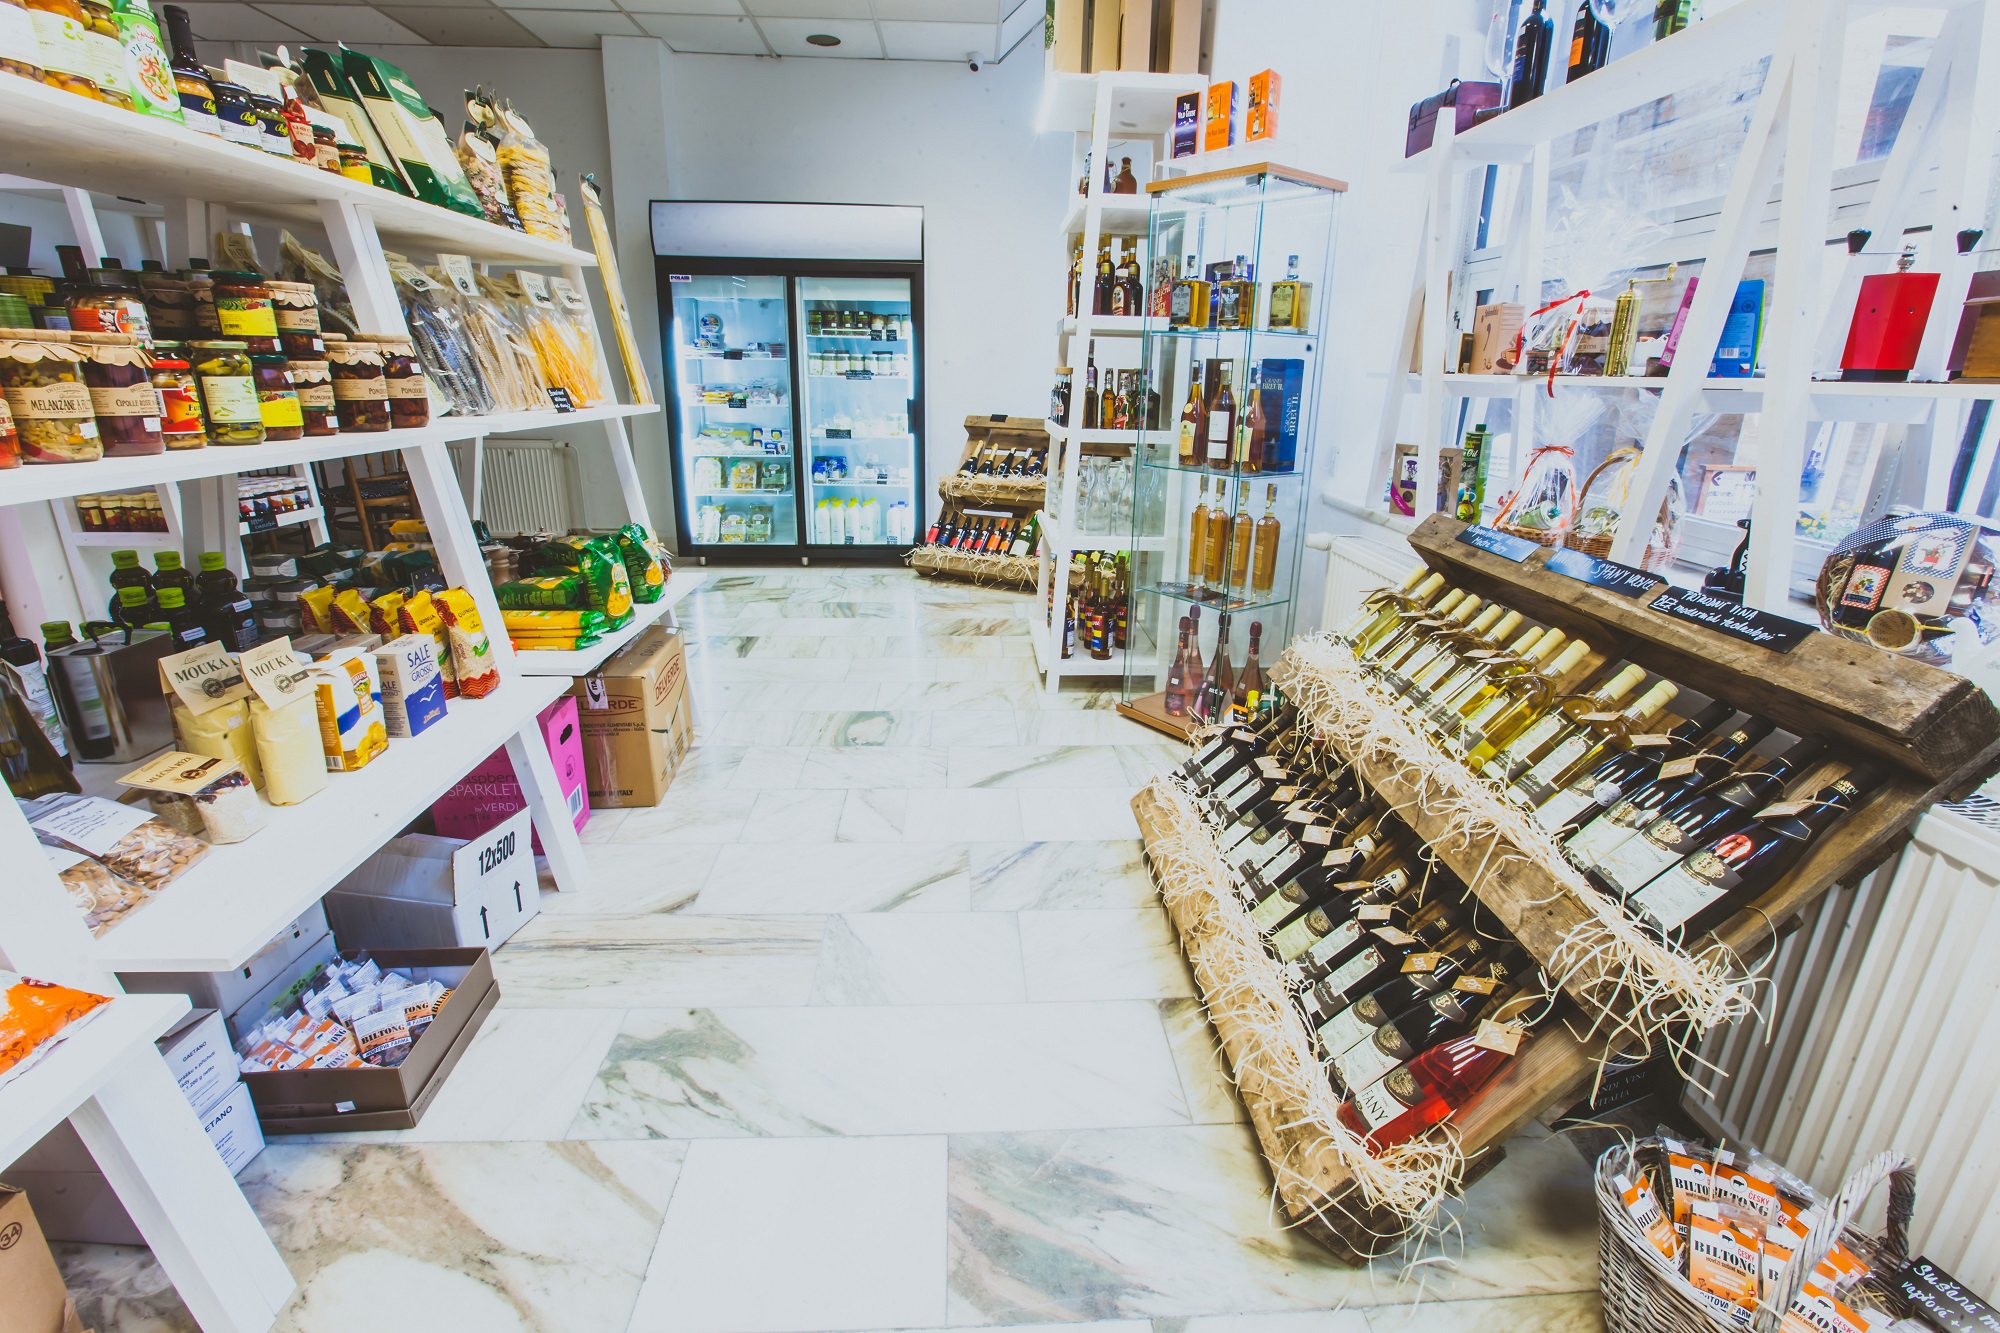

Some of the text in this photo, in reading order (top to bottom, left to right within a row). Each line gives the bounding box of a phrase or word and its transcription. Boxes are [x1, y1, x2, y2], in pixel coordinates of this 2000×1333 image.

[31, 399, 76, 411] MELANZANE
[249, 654, 294, 679] MOUKA
[407, 643, 431, 668] SALE
[174, 657, 229, 684] MOUKA
[411, 662, 434, 682] GROSSO
[655, 657, 680, 700] DELVERDE
[448, 783, 518, 797] SPARKLET
[464, 772, 518, 785] aspberr
[482, 803, 519, 812] VERDI
[478, 831, 516, 877] 12x500
[432, 988, 452, 1014] BILTON
[361, 1024, 405, 1045] BILTONG
[183, 1041, 207, 1063] GAETANO
[1361, 1088, 1389, 1122] FANY
[204, 1105, 233, 1133] ETANO
[1748, 1190, 1770, 1206] ČESKÝ
[0, 1225, 20, 1248] 34
[1693, 1239, 1756, 1275] BILTONG
[1706, 1256, 1721, 1267] HOVĚZÍ
[1721, 1262, 1737, 1275] SUŠENÉ
[1737, 1248, 1756, 1263] ČESKÝ
[1912, 1264, 1985, 1315] Sušená
